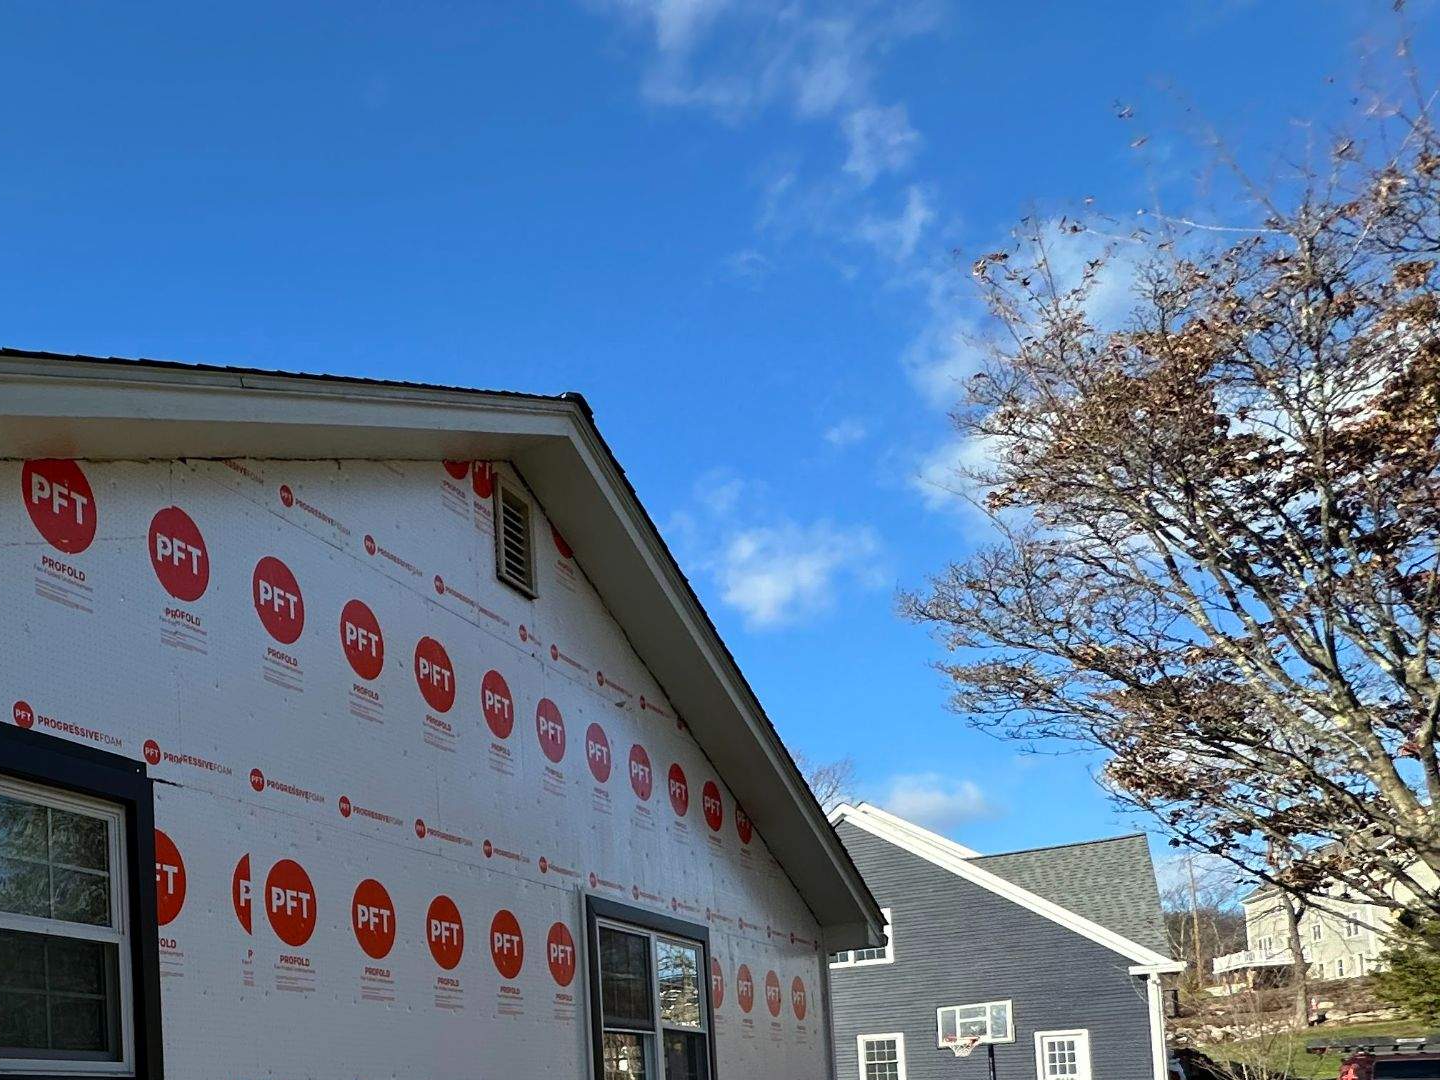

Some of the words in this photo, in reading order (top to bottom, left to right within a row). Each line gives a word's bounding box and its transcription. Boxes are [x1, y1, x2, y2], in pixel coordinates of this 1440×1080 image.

[32, 473, 88, 525] PFT
[156, 532, 202, 577] PFT
[41, 555, 86, 582] PROFOLD
[259, 579, 298, 620] PFT
[346, 620, 379, 658] PFT
[267, 648, 298, 667] PROFOLD
[485, 689, 510, 719] PFT
[15, 708, 32, 722] PFT
[38, 715, 122, 748] PROGRESSIVEFOAM
[539, 716, 562, 745] PFT
[145, 747, 159, 758] PFT
[589, 741, 608, 765] PFT
[632, 761, 650, 785] PFT
[266, 779, 325, 802] PROGRESSIVEFOAM
[670, 778, 686, 801] PFT
[704, 795, 720, 817] PFT
[271, 887, 311, 919] PFT
[358, 905, 391, 933] PFT
[431, 920, 460, 946] PFT
[493, 931, 520, 957] PFT
[280, 954, 310, 967] PROFOLD
[550, 944, 573, 966] PFT
[364, 966, 391, 978] PROFOLD
